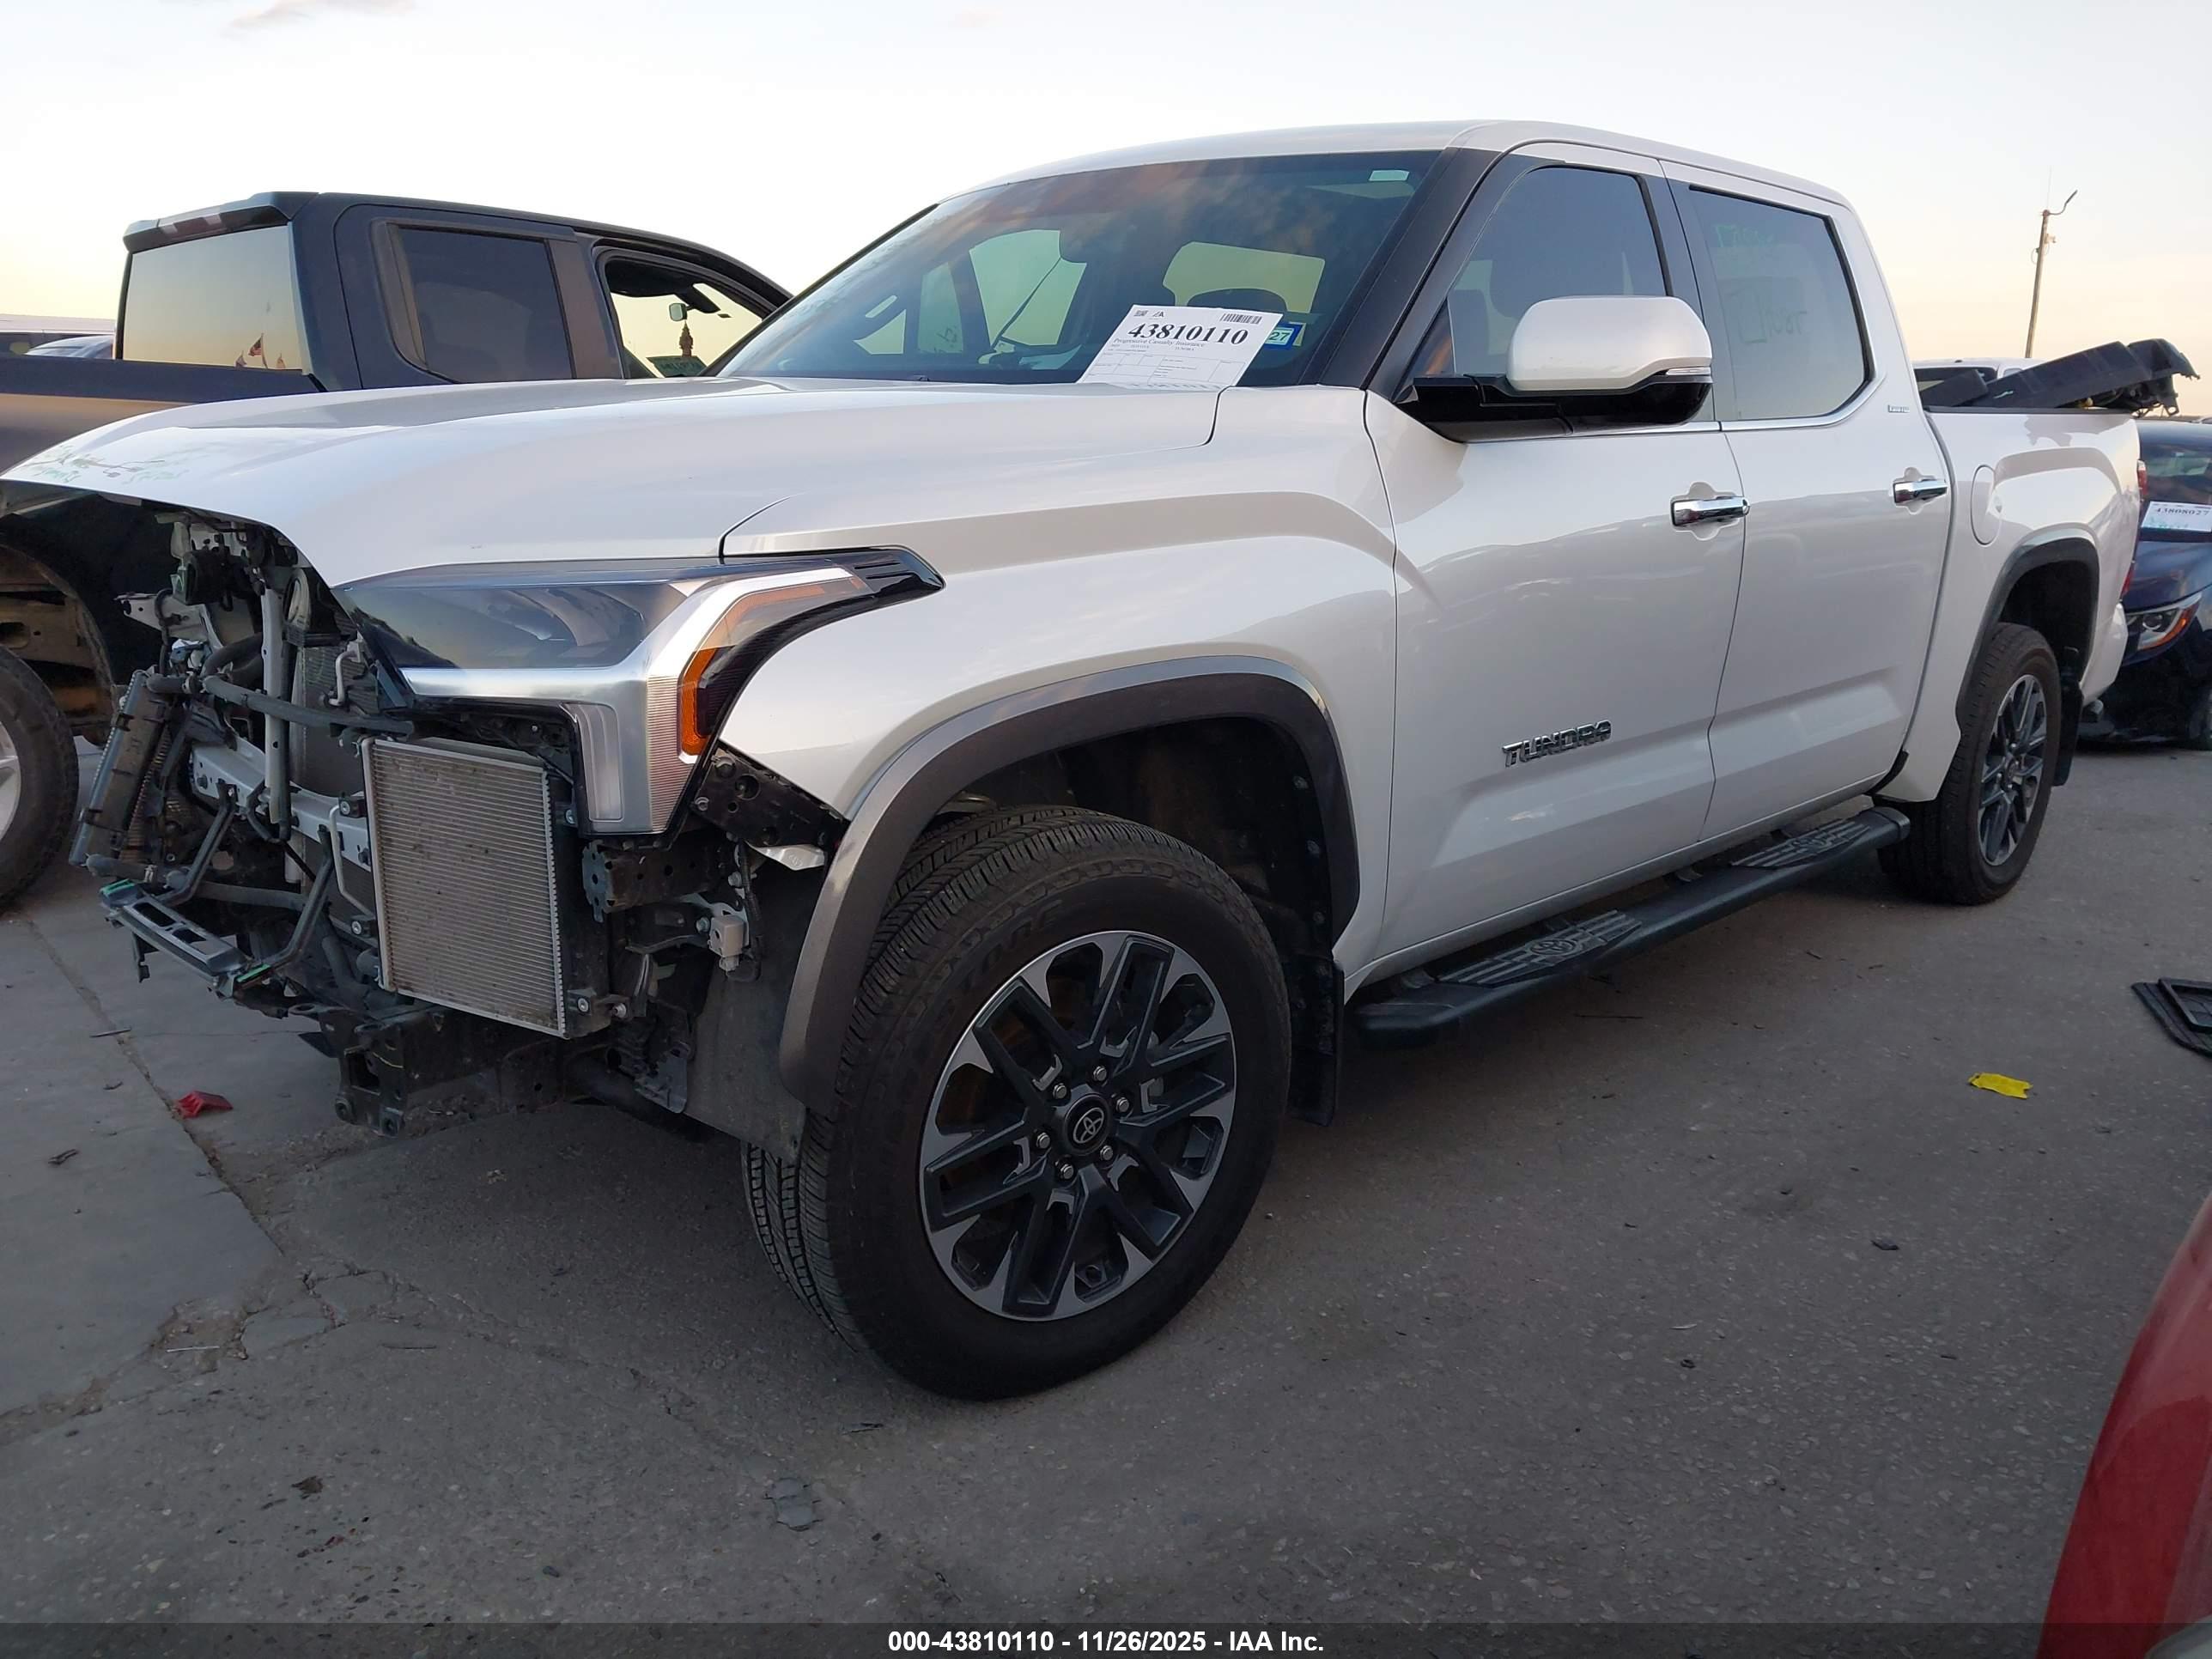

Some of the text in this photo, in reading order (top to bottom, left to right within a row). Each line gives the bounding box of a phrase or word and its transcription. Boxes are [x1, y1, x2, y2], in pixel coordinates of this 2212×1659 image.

[1128, 323, 1249, 345] 43810110
[1269, 331, 1290, 342] 27
[1502, 720, 1612, 767] TUNDRA
